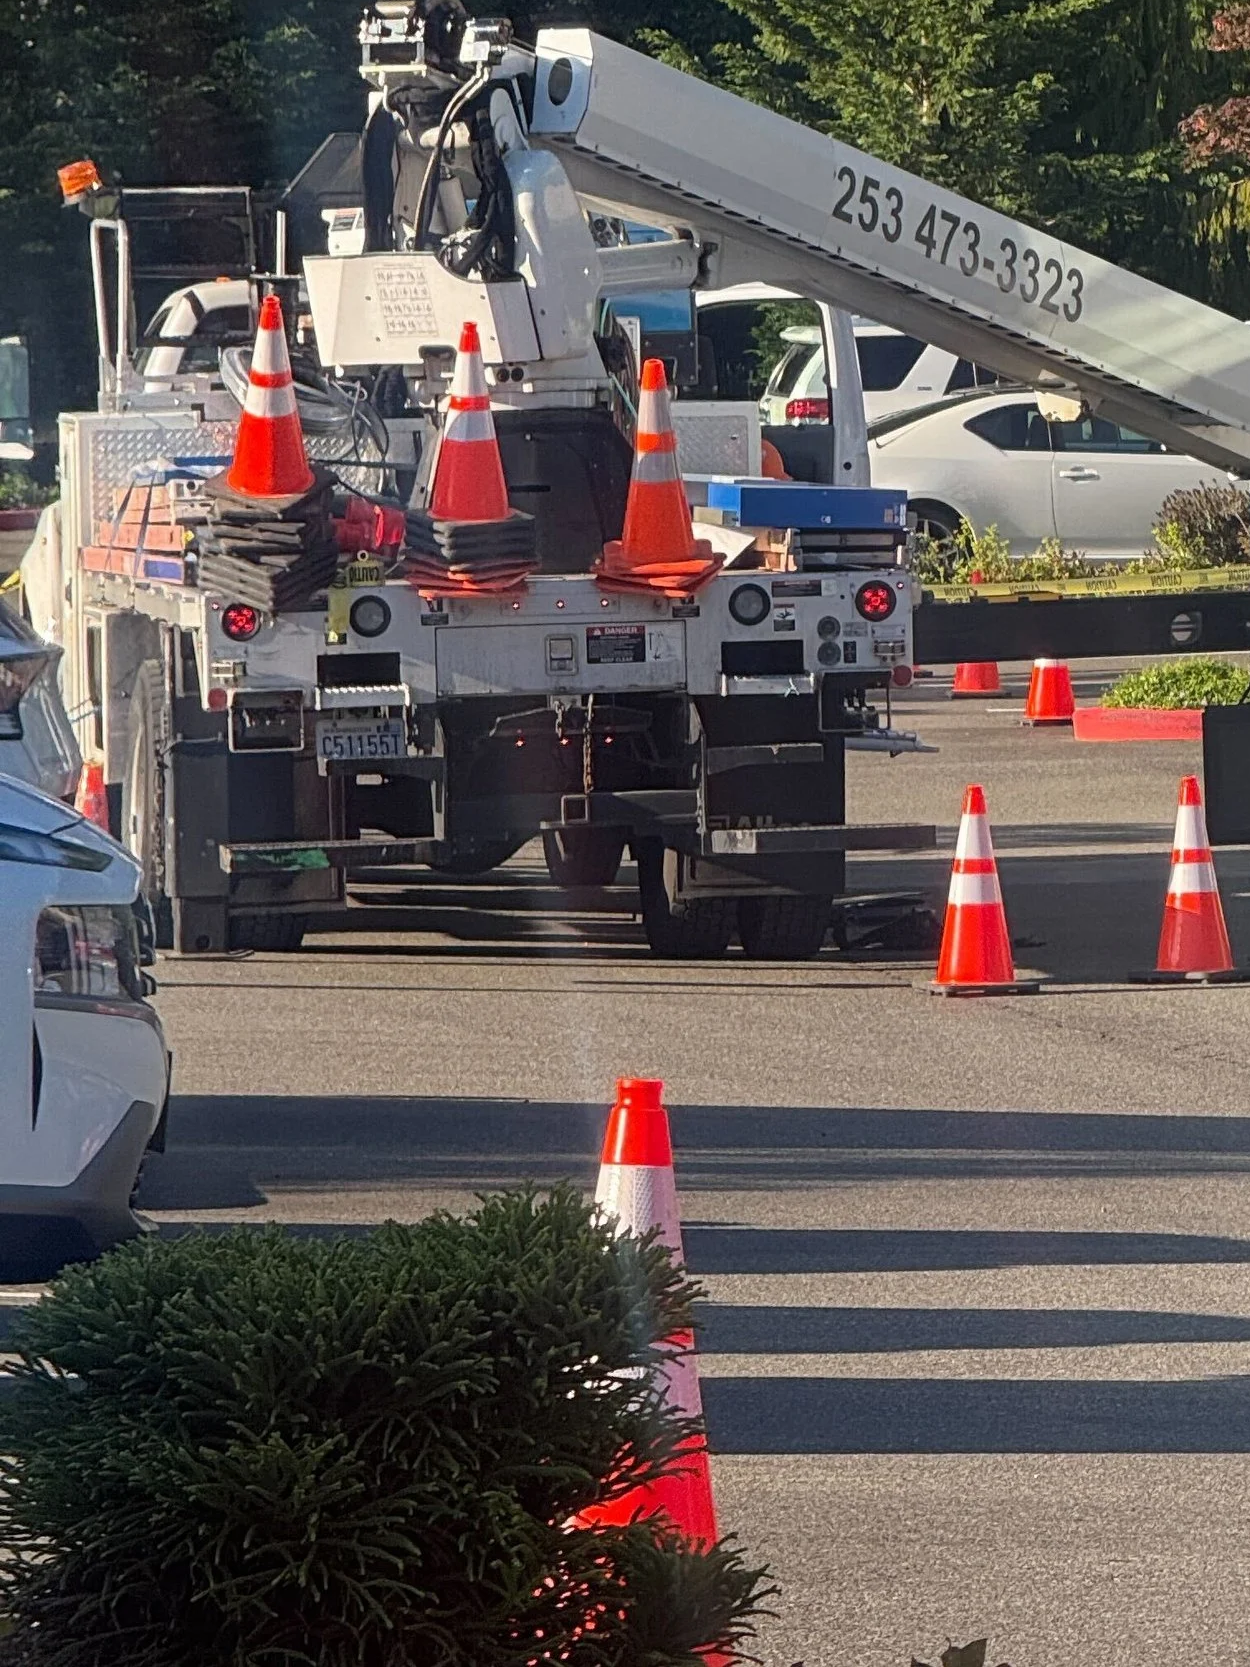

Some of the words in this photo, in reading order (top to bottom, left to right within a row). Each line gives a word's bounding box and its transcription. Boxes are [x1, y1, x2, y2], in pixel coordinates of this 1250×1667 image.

[832, 165, 904, 243] 253
[914, 203, 1084, 323] 473-3323
[604, 626, 638, 635] DANGER
[322, 735, 400, 756] C51155T
